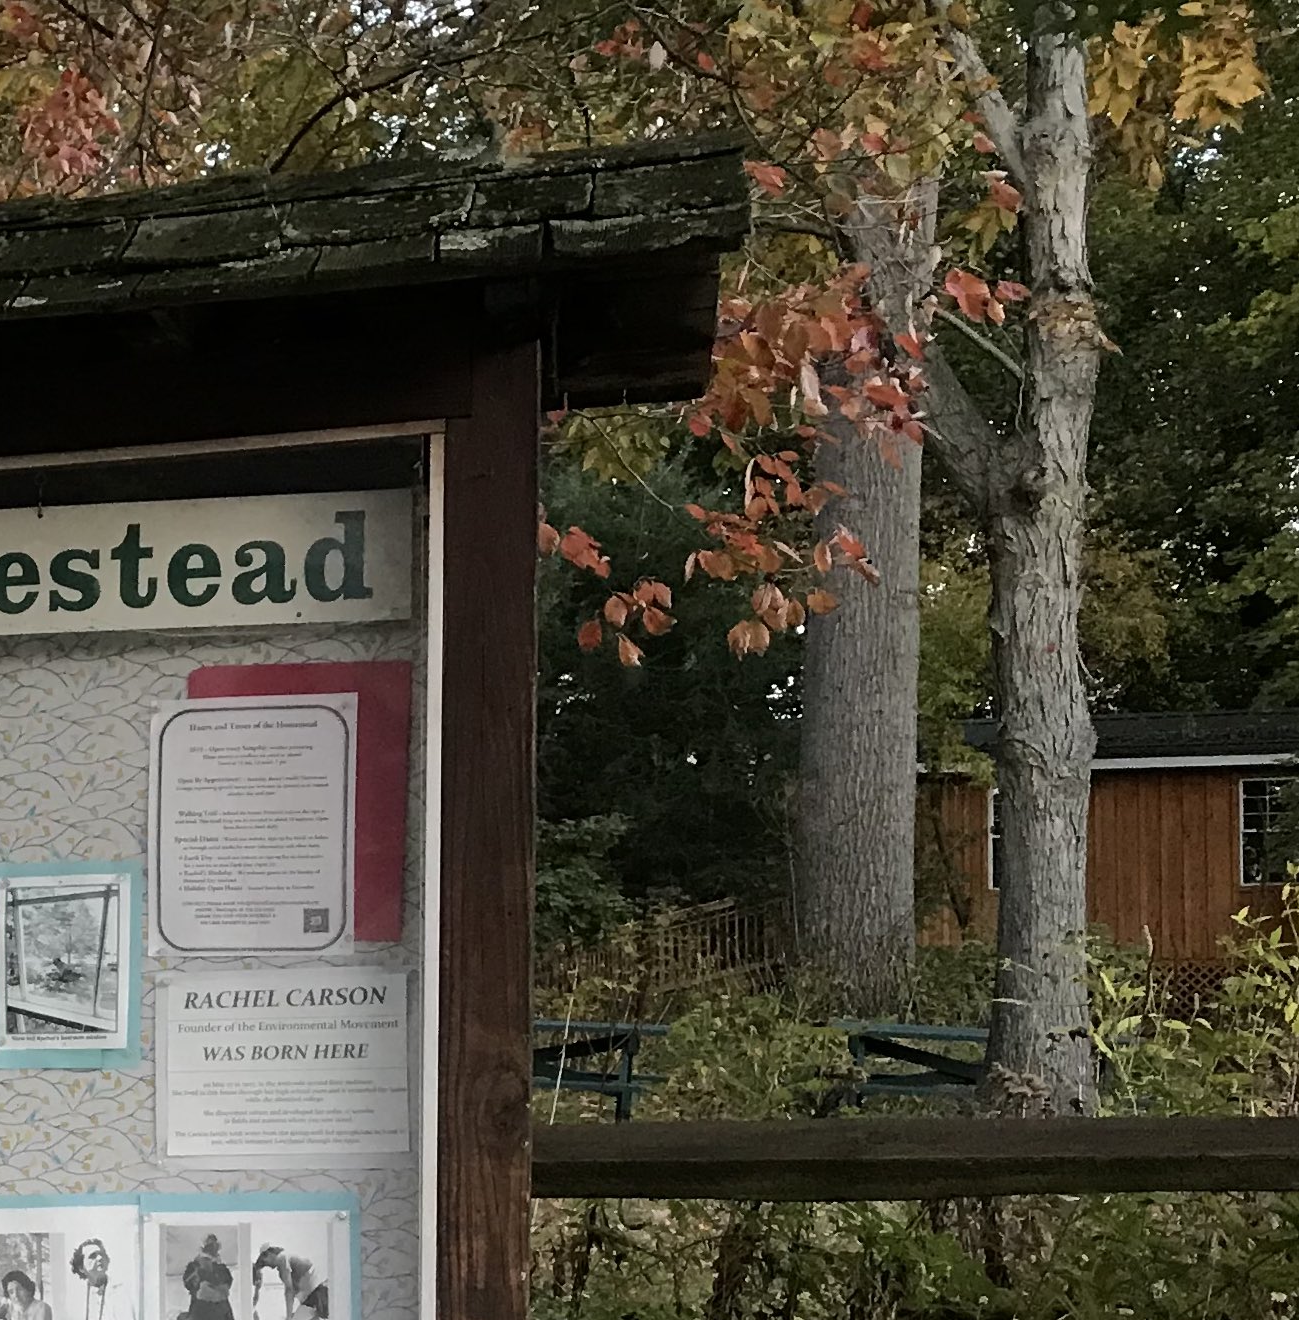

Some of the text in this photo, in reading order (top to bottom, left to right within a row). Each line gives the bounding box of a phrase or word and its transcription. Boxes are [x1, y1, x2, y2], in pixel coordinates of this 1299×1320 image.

[184, 986, 388, 1010] RACHEL CARSON
[178, 1018, 399, 1033] Founder of the Environmental Movement
[202, 1043, 369, 1061] WAS BORN HERE
